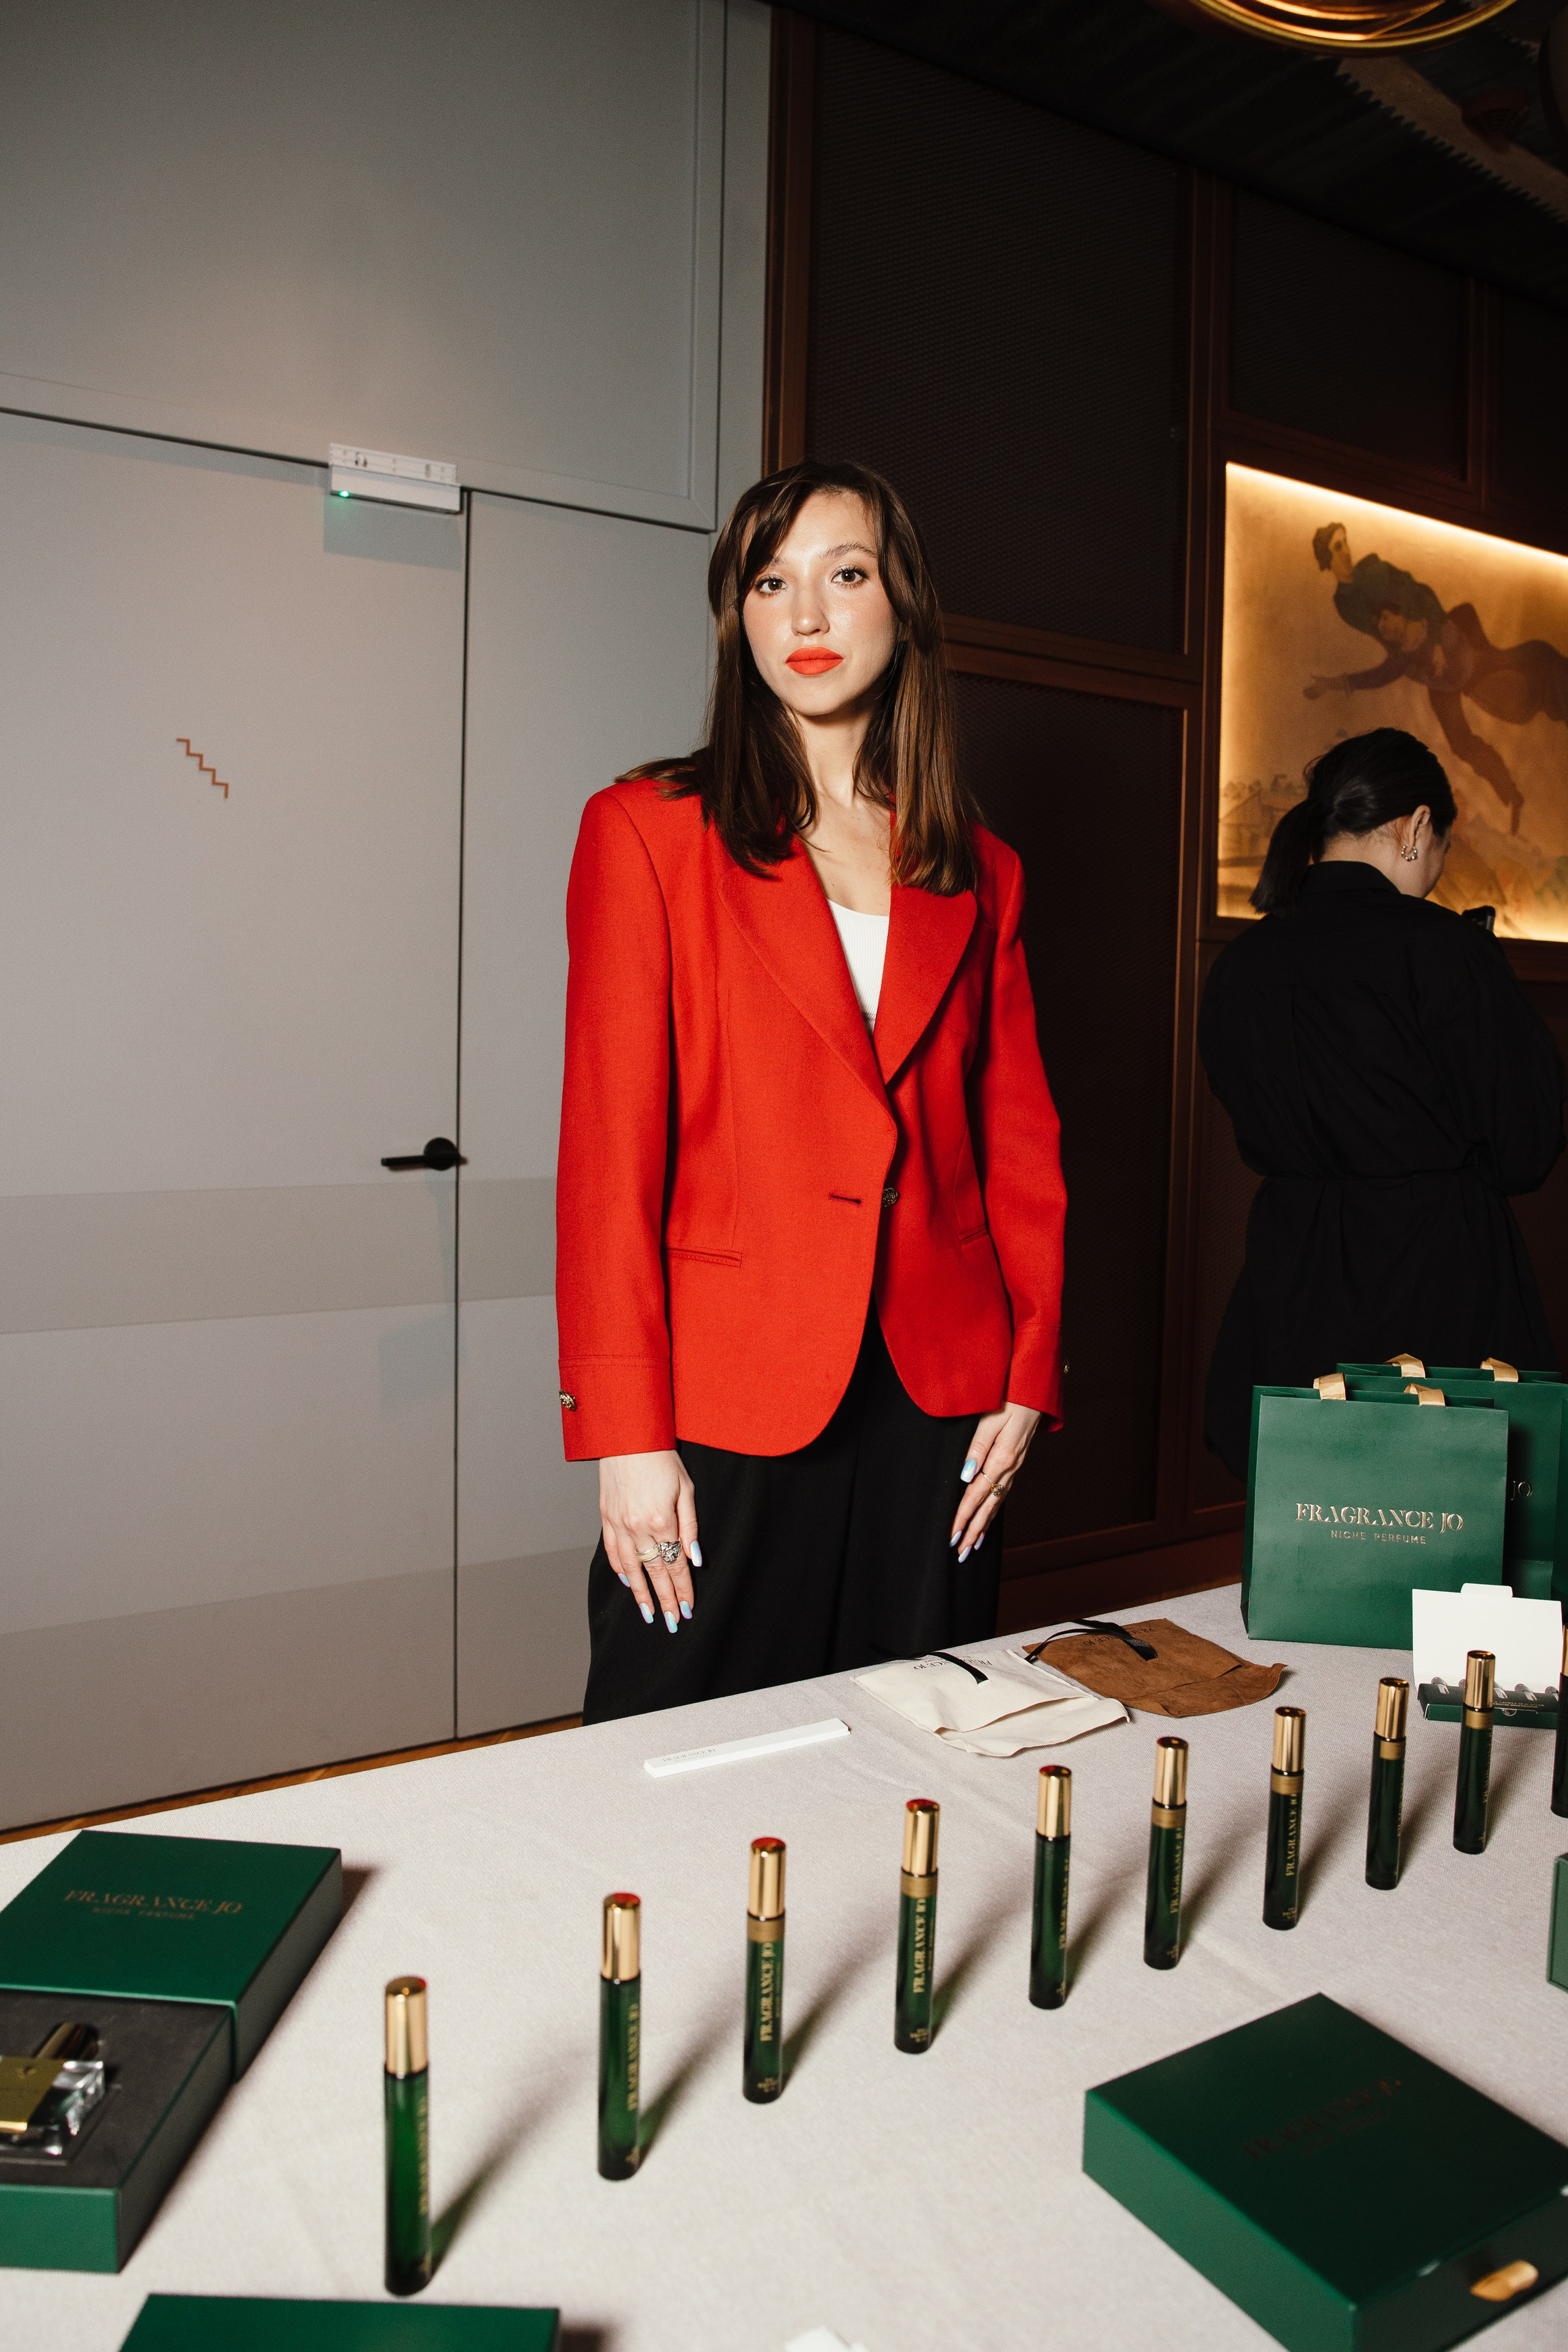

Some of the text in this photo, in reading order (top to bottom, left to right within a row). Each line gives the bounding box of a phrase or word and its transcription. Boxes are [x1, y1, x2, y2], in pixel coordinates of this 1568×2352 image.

[1510, 1480, 1533, 1501] JO
[1295, 1502, 1464, 1534] FRAGRANCE JO
[1331, 1530, 1427, 1544] NICHE PERFUME
[1286, 1809, 1297, 1877] FRAGRANCE
[64, 1890, 213, 1911] FRAGRANCE
[913, 1914, 927, 1994] FRAGRANCE
[760, 1942, 775, 2042] FRAGRANCE JO
